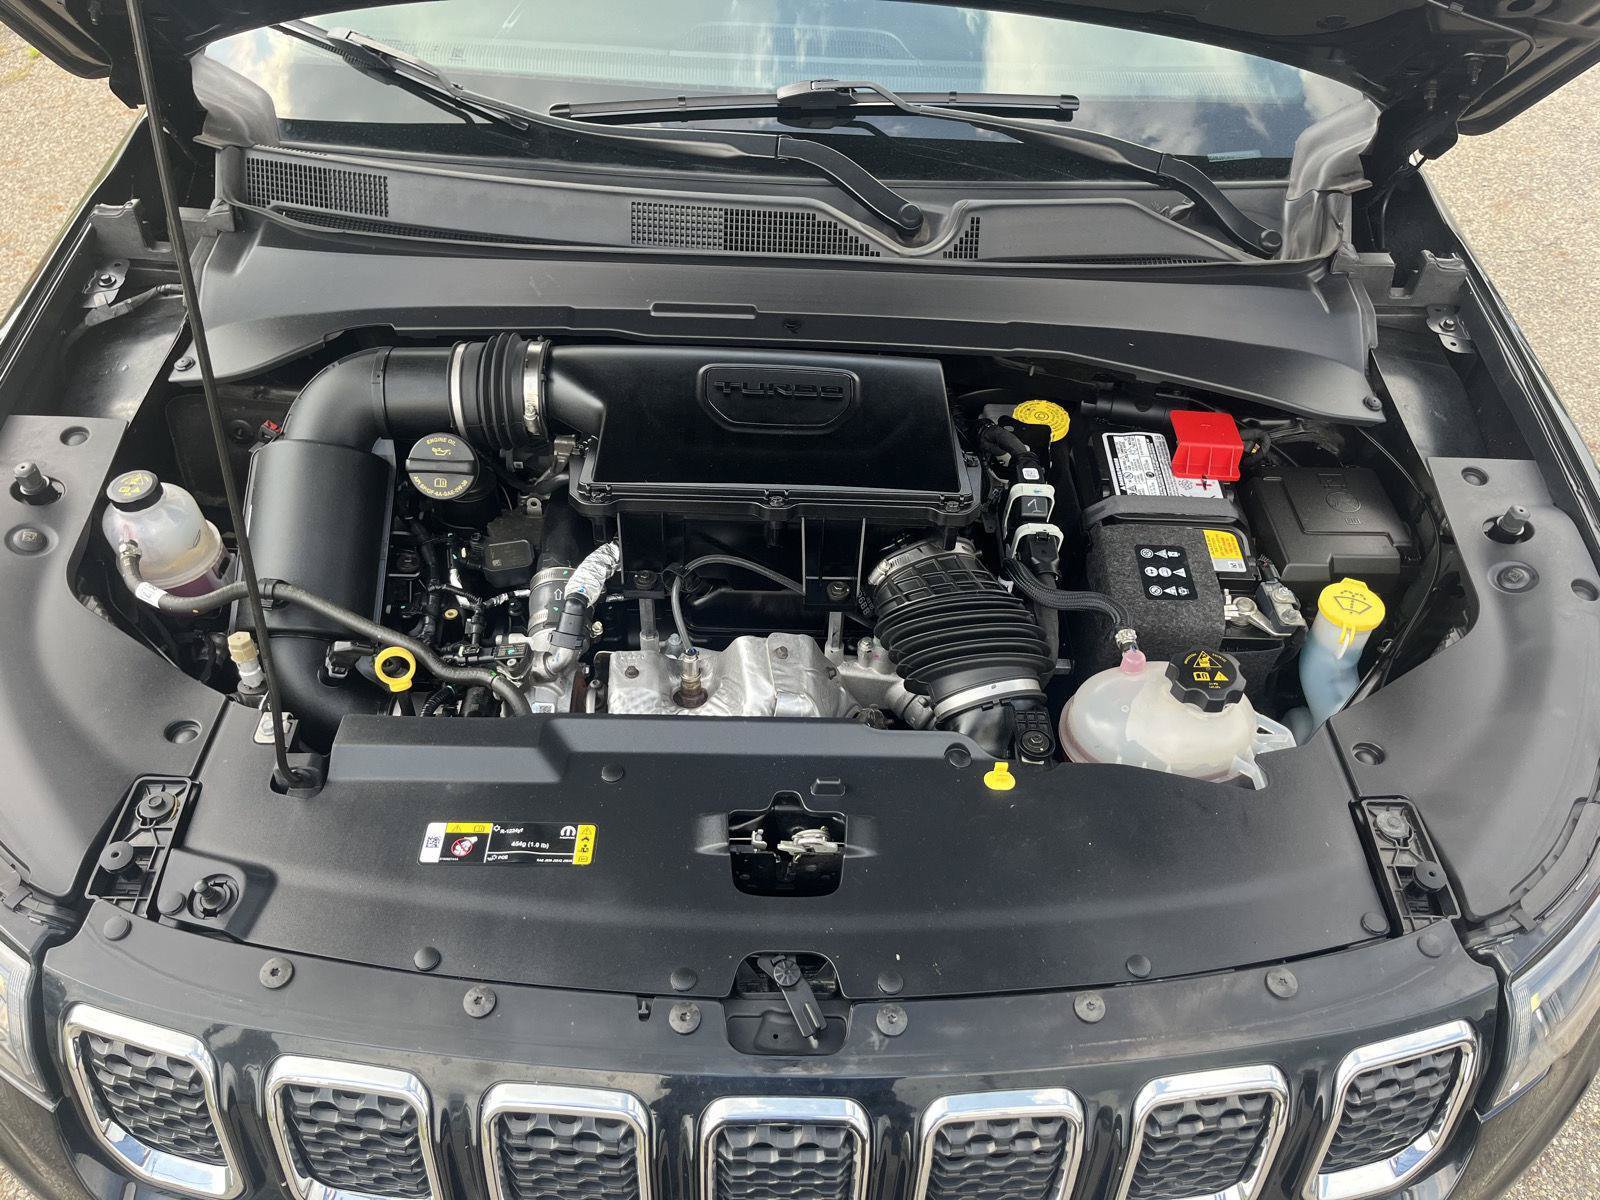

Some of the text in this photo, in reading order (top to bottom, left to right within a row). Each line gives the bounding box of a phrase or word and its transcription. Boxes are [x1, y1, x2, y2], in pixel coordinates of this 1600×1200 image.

[714, 381, 844, 398] TURBO
[426, 437, 456, 447] ENGINE OIL
[511, 840, 527, 848] 454g
[540, 842, 550, 850] lb)
